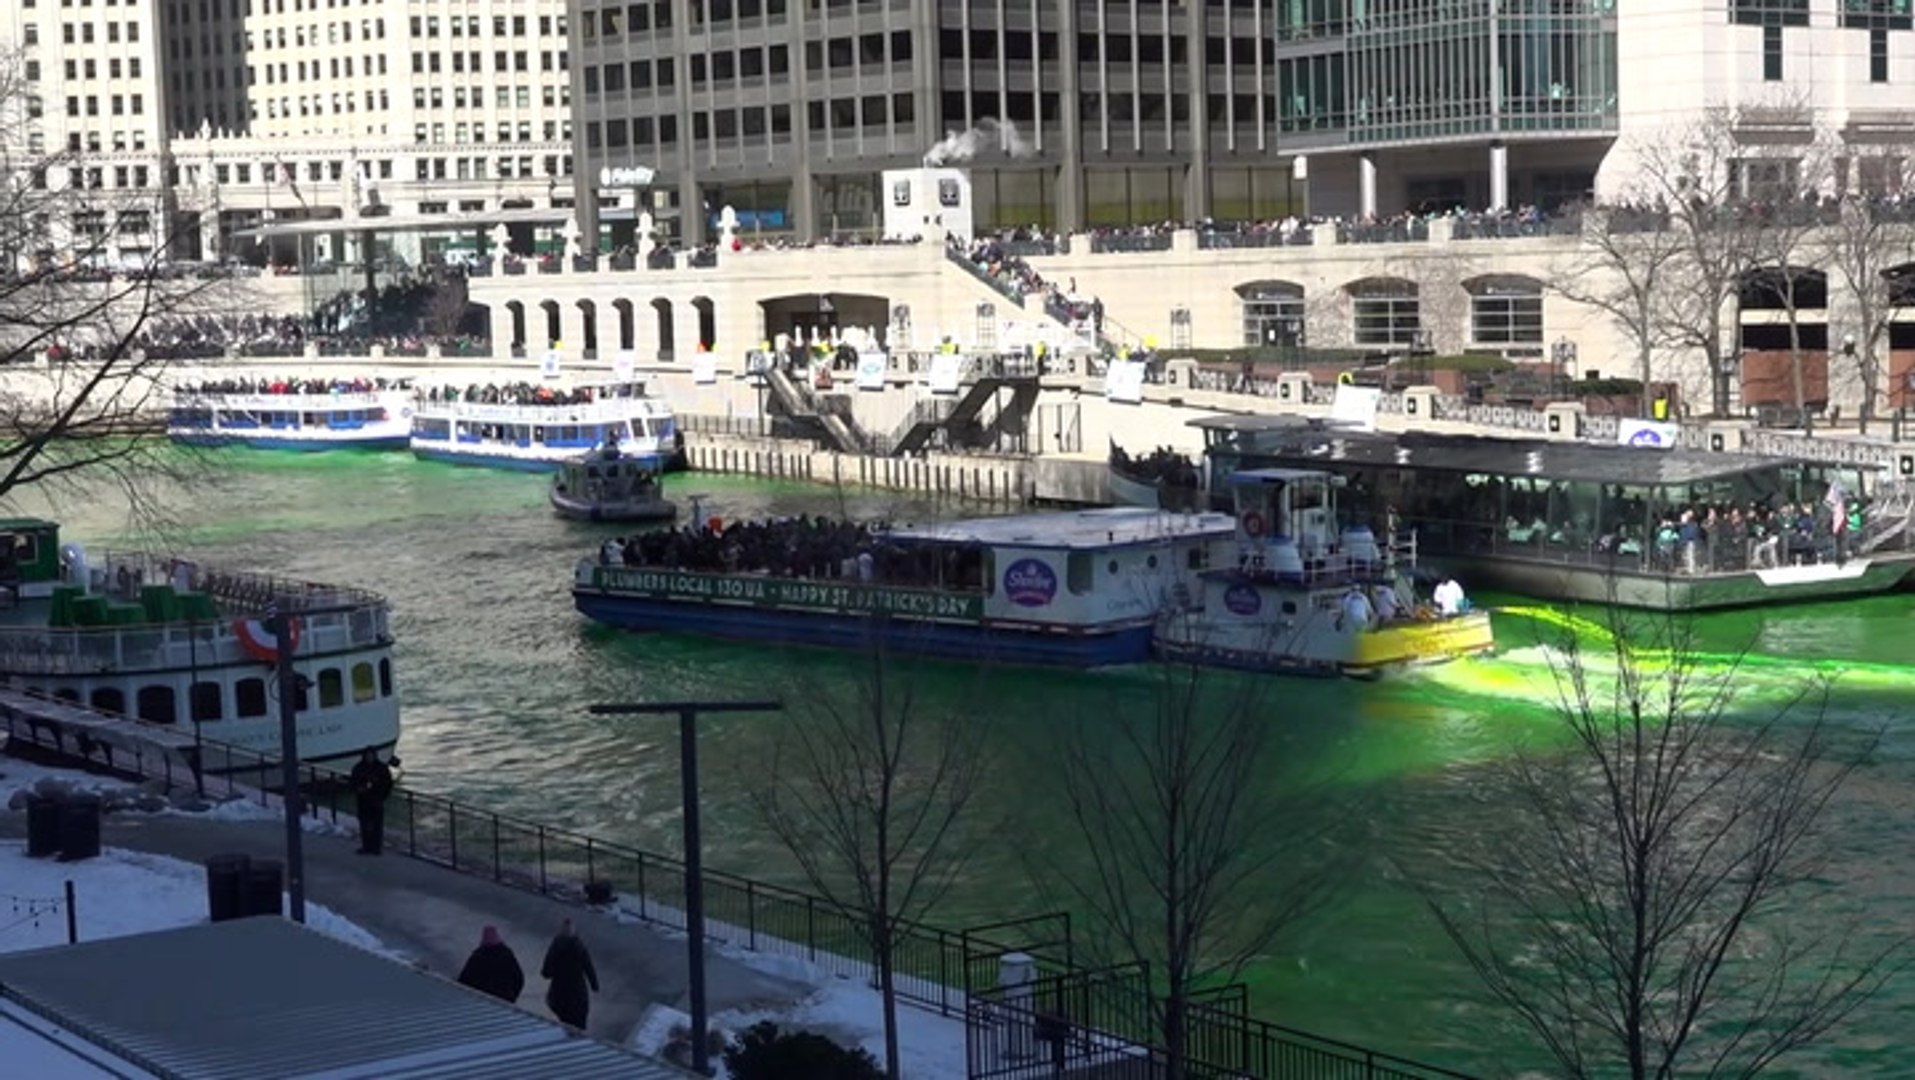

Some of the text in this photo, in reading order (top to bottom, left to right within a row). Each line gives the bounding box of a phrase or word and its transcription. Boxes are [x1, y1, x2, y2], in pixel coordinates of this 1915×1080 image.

[602, 571, 666, 590] PLUMBERS
[670, 575, 712, 594] LOCAL
[718, 579, 742, 597] 130
[782, 585, 828, 603] HAPPY
[938, 597, 970, 616] DAY
